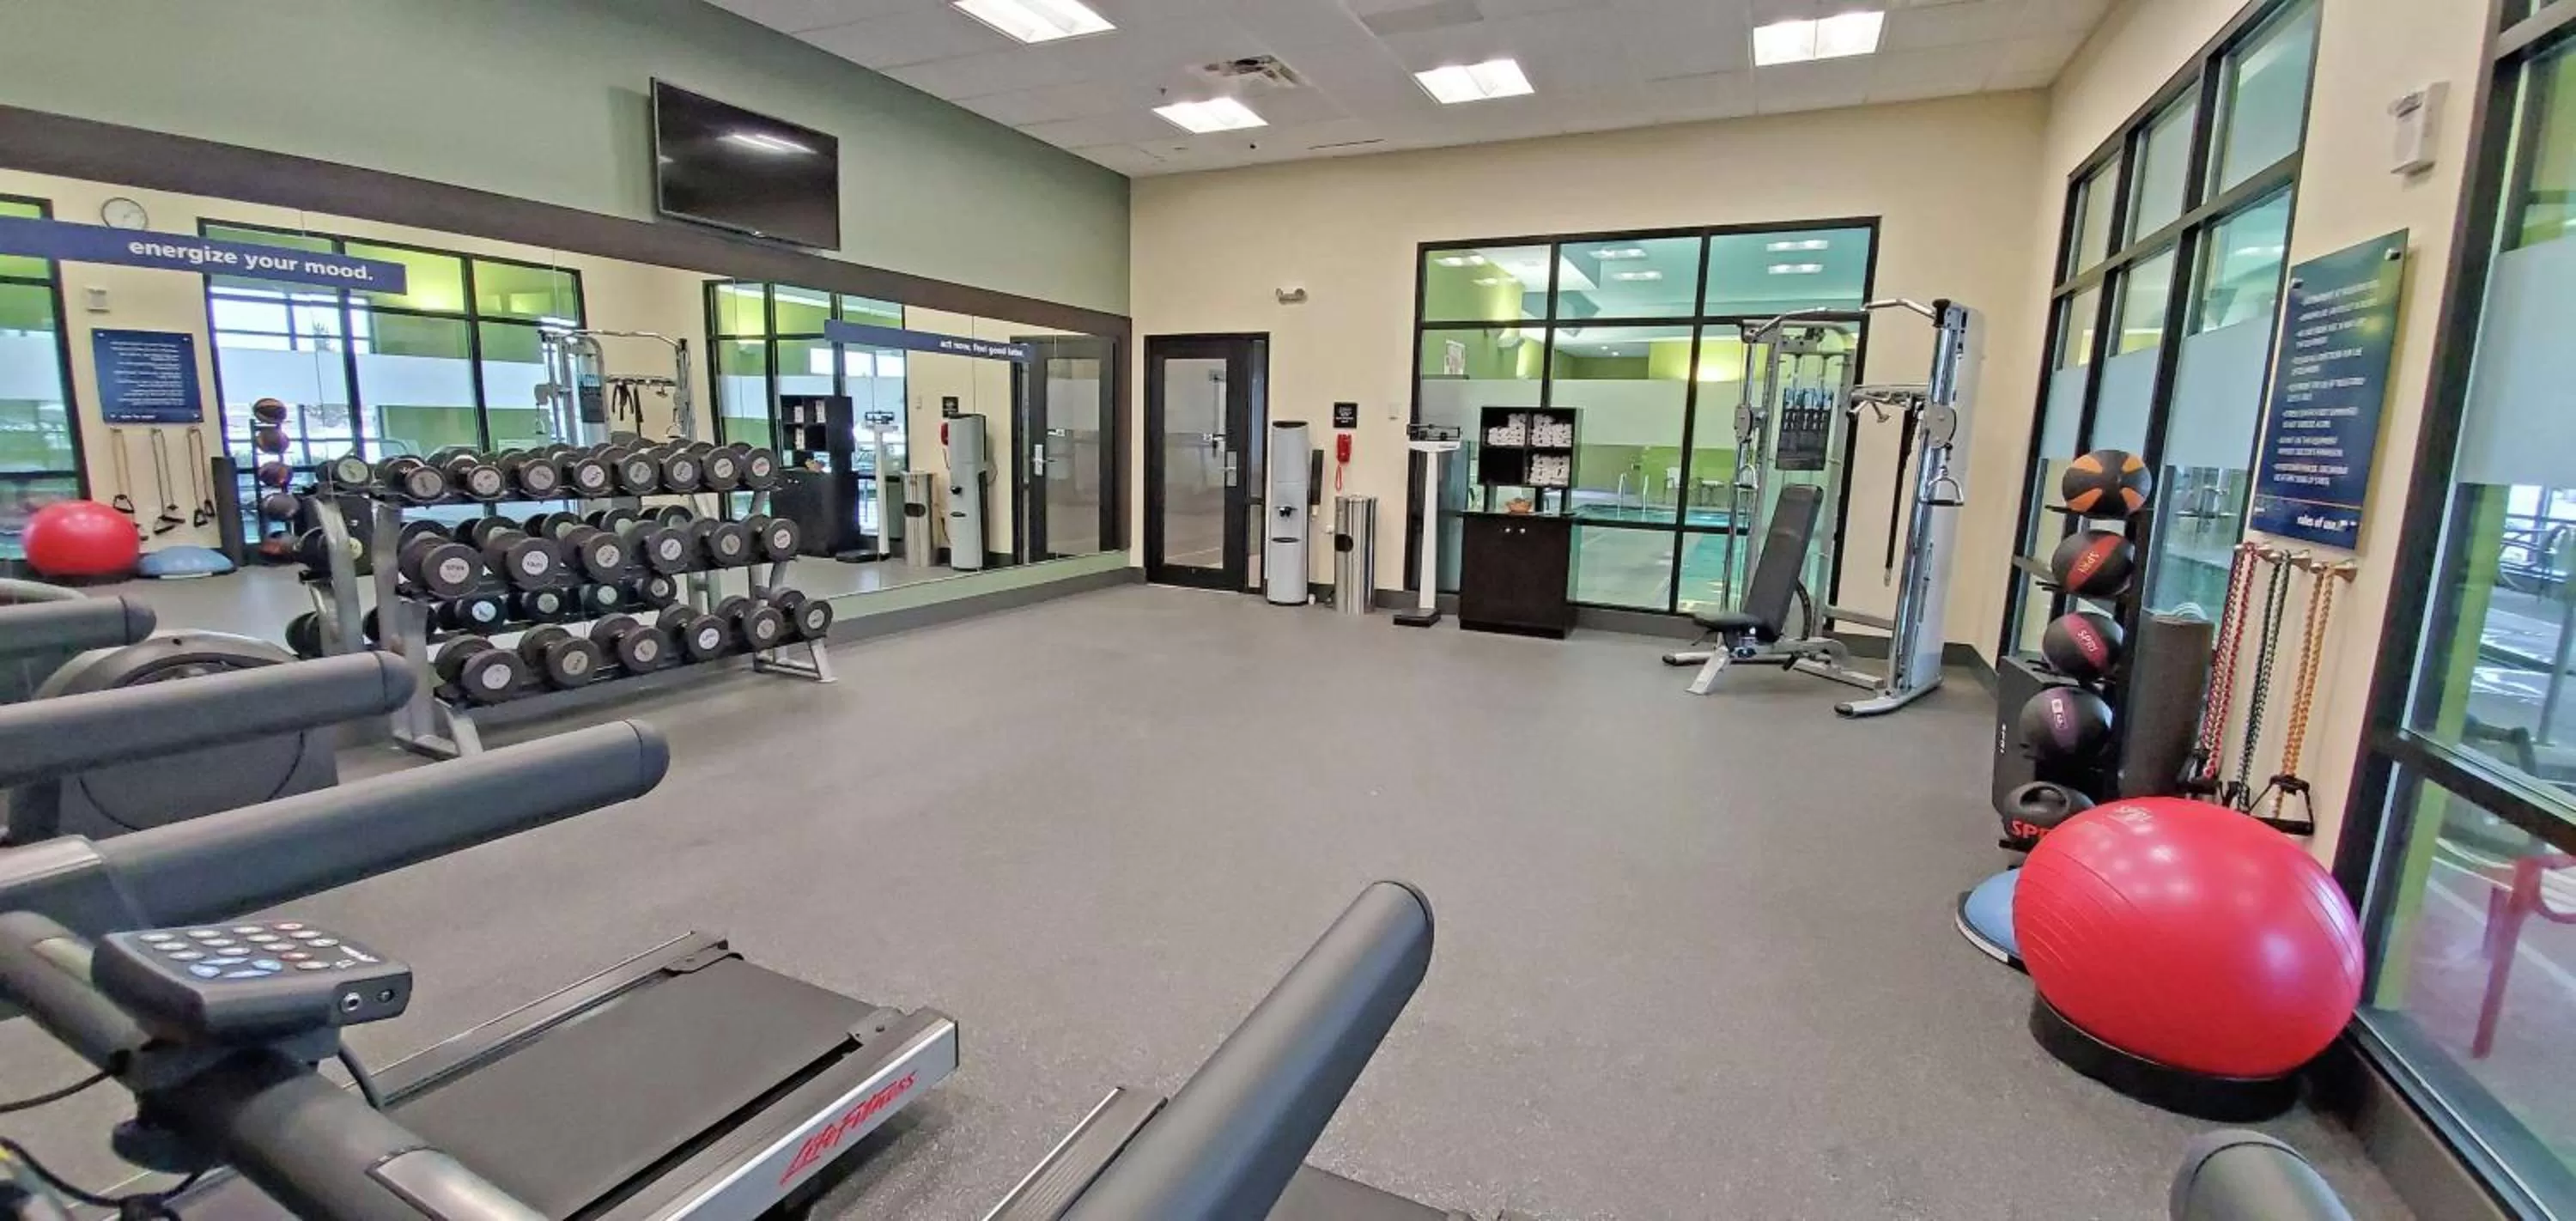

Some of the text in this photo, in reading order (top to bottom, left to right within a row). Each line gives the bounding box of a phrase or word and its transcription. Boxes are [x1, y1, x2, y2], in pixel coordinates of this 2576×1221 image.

[128, 240, 374, 282] energize your mood.
